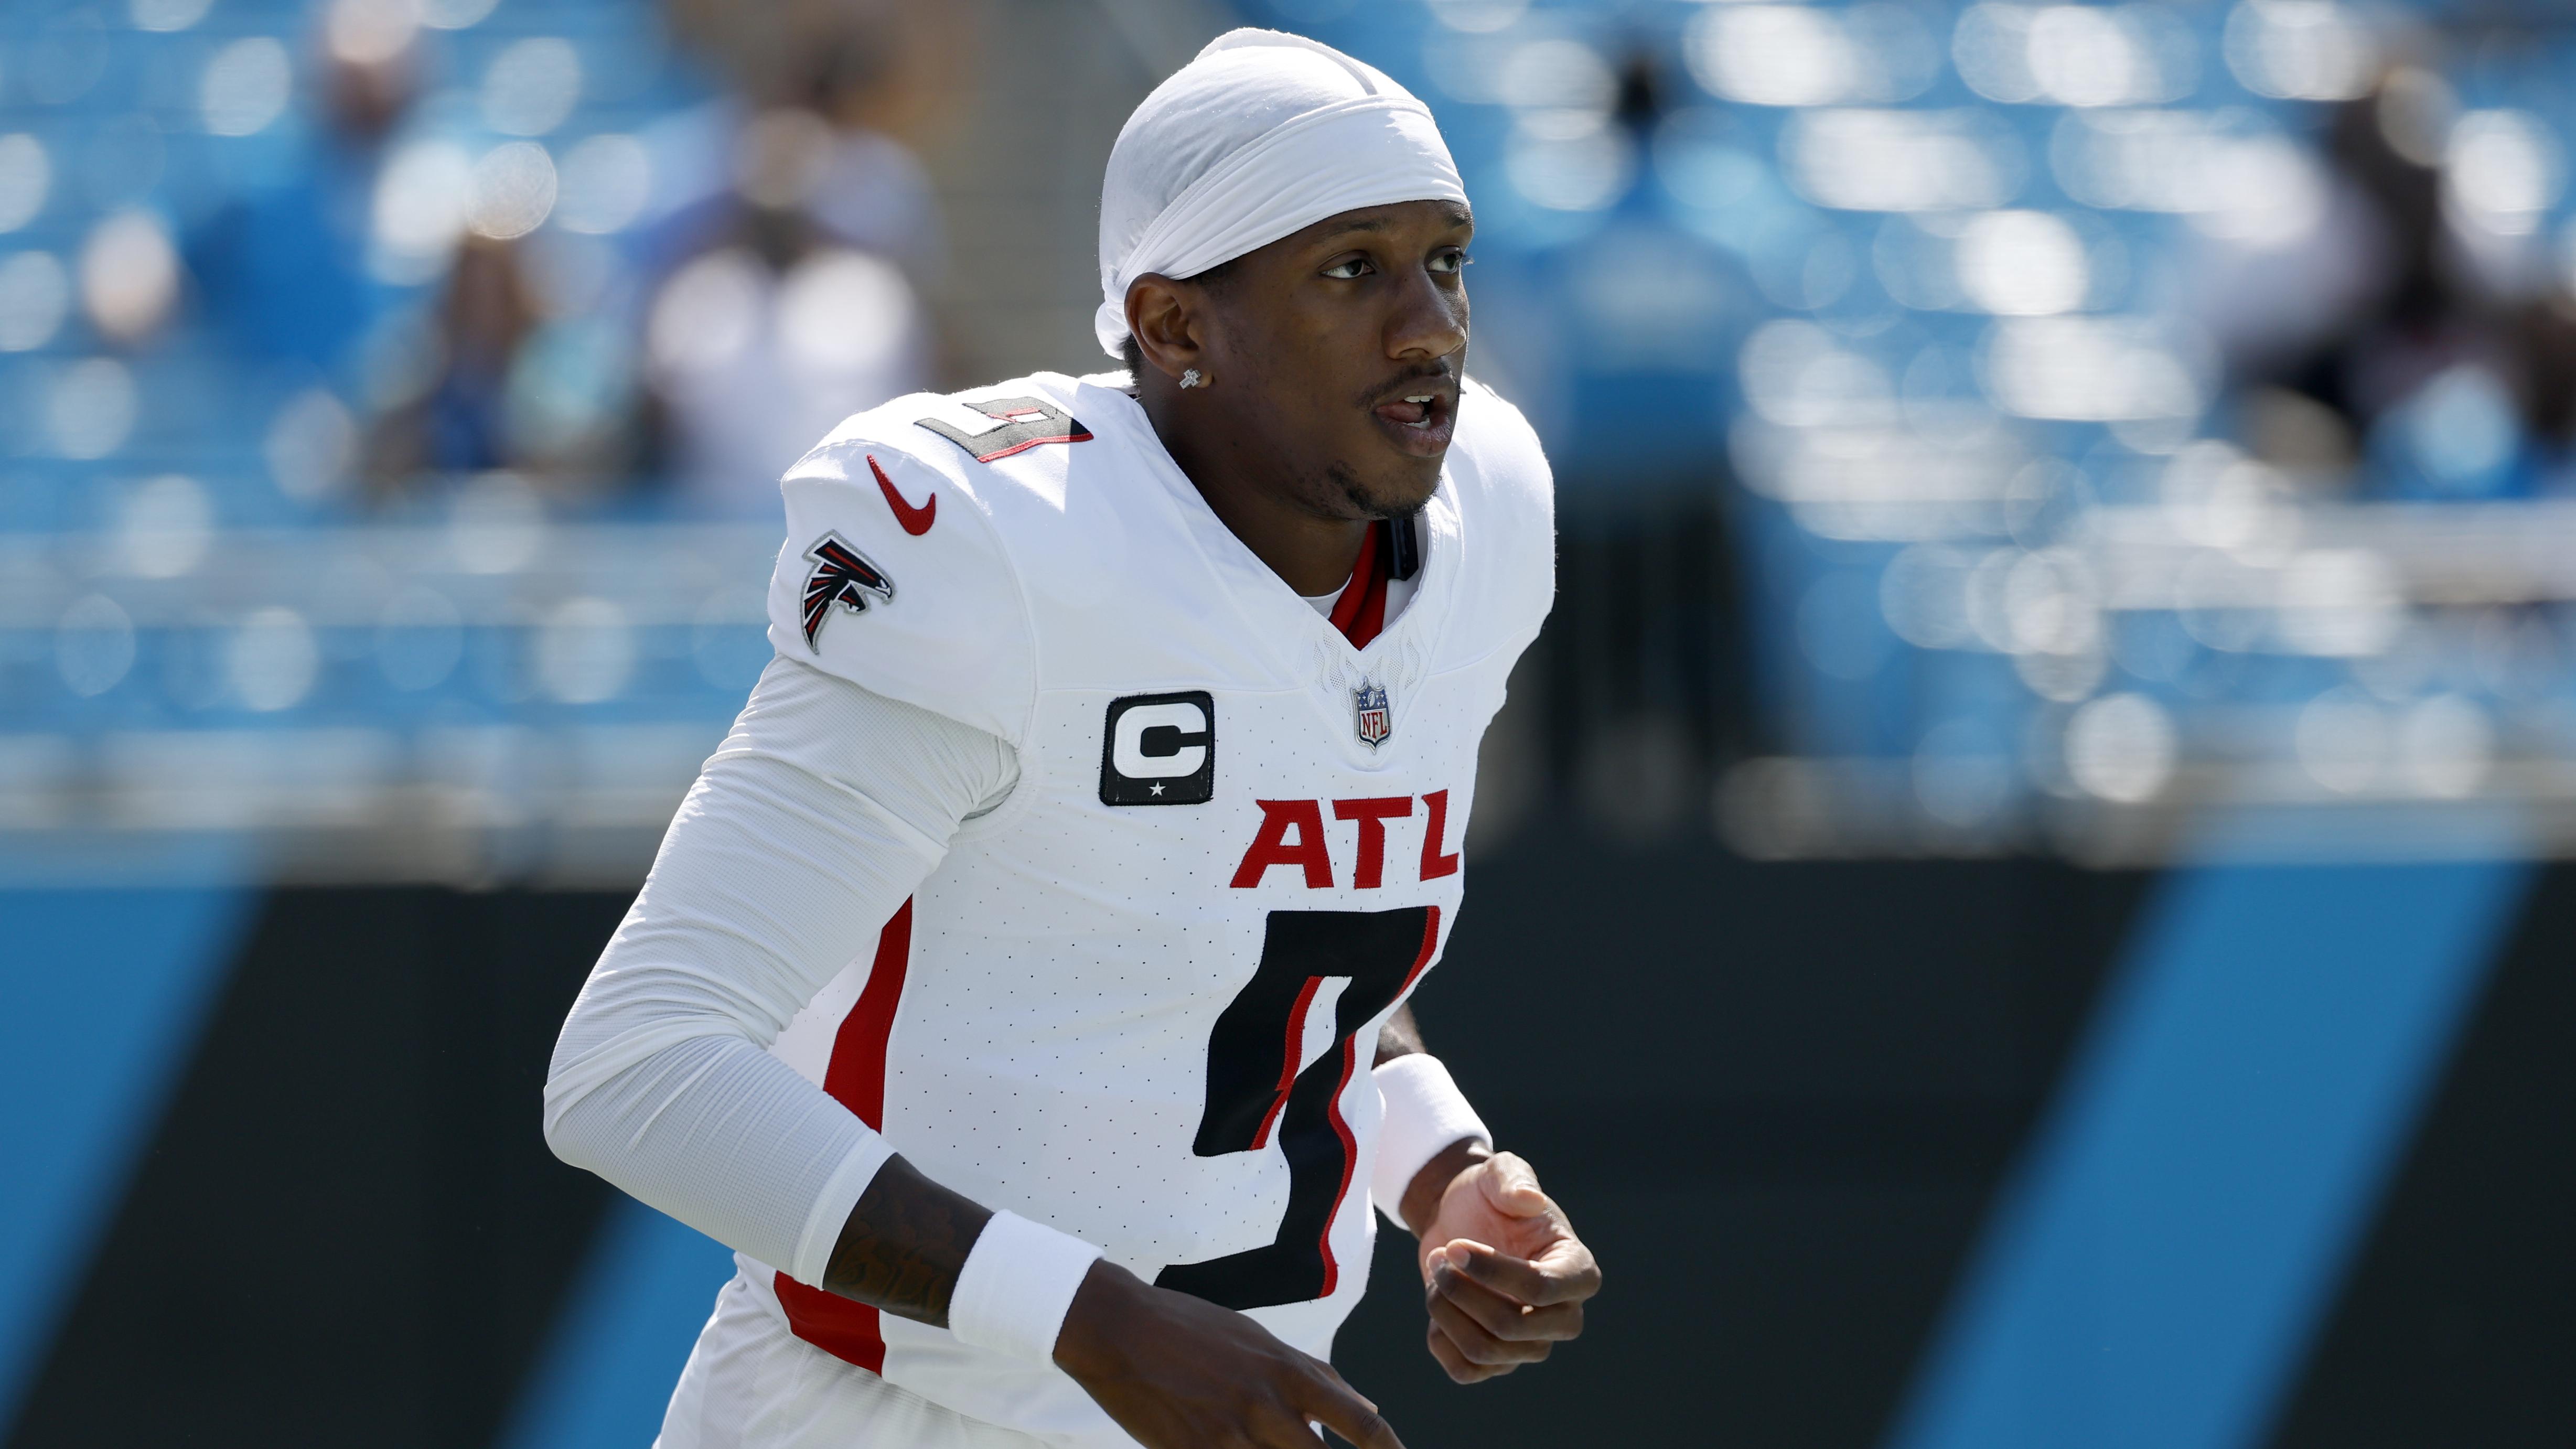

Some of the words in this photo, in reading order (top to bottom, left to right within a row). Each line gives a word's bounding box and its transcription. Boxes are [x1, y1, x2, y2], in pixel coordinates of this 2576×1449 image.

[1113, 702, 1206, 778] C
[1361, 711, 1388, 739] NFL
[1230, 789, 1459, 889] ATL
